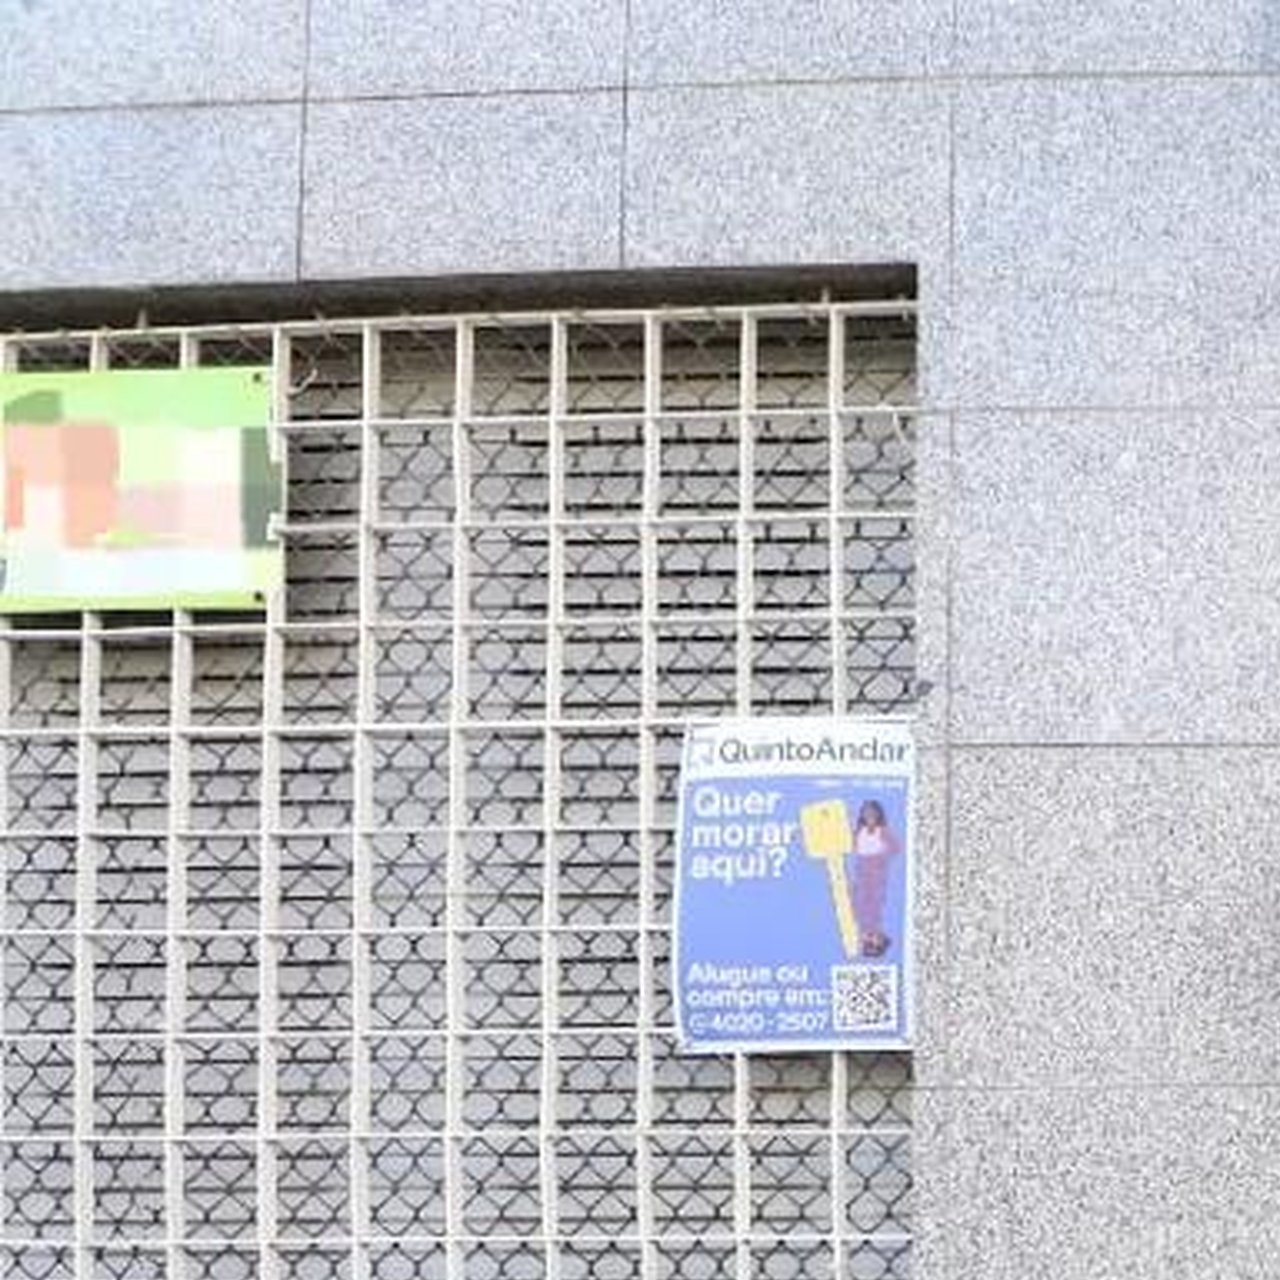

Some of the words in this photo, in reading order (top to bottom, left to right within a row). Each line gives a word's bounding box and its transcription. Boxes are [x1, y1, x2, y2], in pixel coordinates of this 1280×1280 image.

[720, 738, 910, 764] QuintoAndar
[694, 786, 781, 817] Quer
[692, 821, 798, 848] morar
[692, 848, 788, 885] aqui?
[688, 963, 772, 987] Alugue
[776, 965, 809, 982] ou
